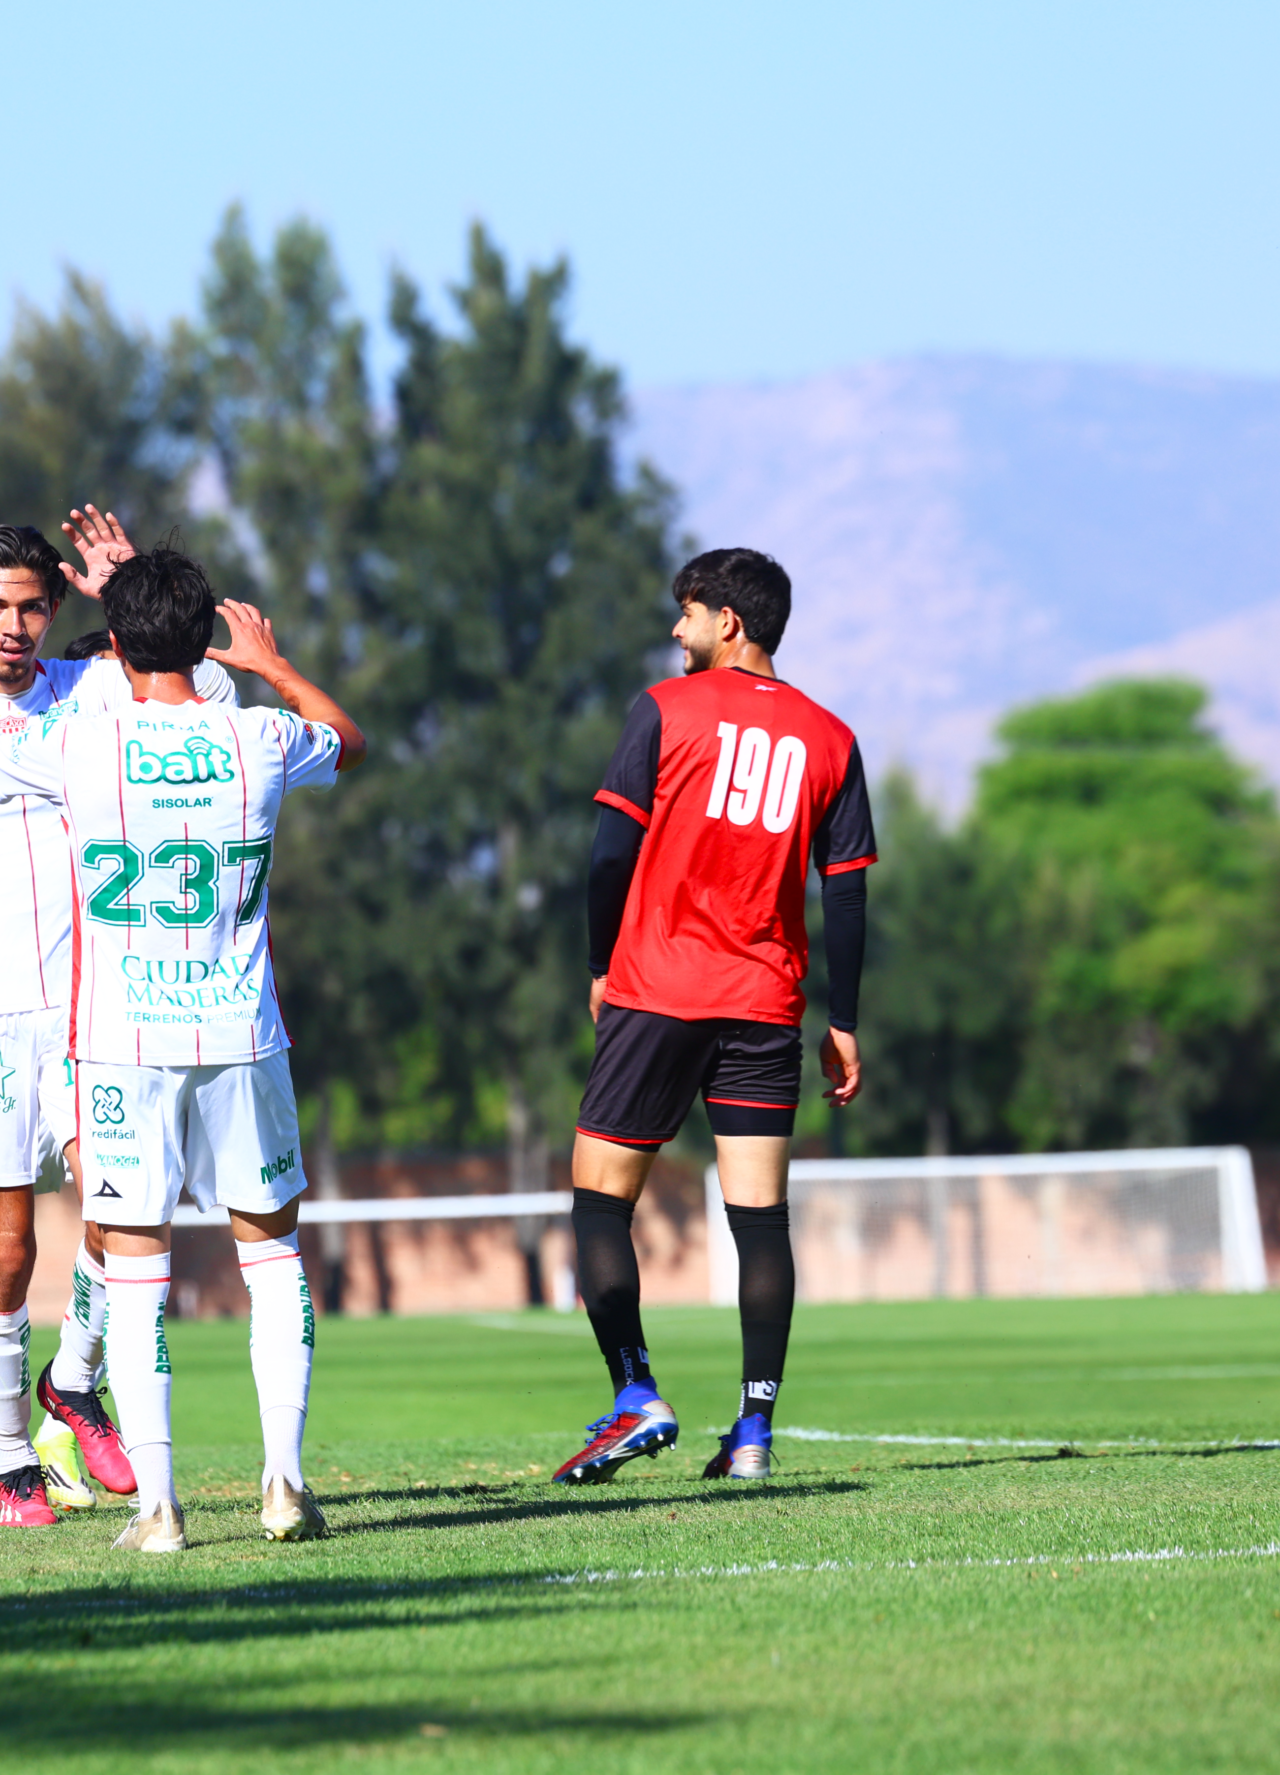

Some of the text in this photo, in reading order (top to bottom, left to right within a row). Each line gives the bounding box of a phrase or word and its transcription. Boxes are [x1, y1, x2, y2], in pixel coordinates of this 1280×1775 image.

[126, 736, 235, 785] bait
[706, 721, 807, 834] 190
[152, 797, 212, 809] SISOLAR
[80, 833, 273, 929] 237
[121, 953, 253, 985] CIUDAD
[127, 978, 260, 1008] MADERAS
[125, 1011, 202, 1024] TERRENOS
[90, 1128, 136, 1140] redifácil
[260, 1148, 295, 1185] Mobil
